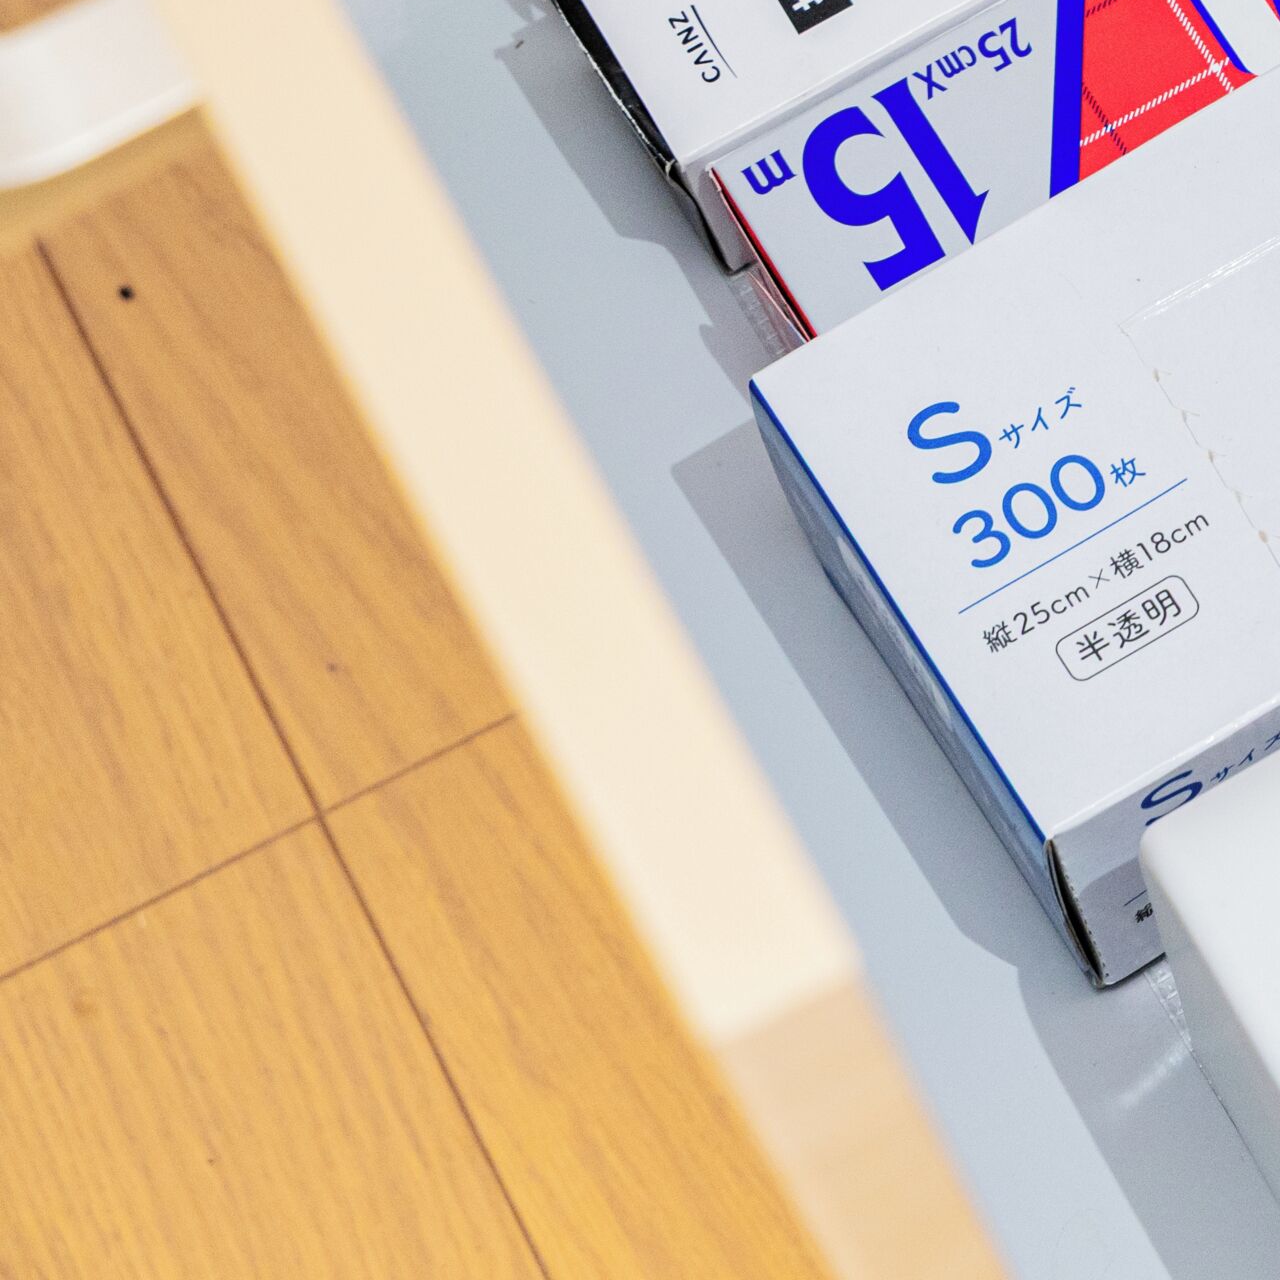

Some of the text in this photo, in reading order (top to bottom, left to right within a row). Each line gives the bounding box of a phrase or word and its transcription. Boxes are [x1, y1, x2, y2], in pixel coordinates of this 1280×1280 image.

[668, 10, 721, 84] CAINZ
[952, 453, 1147, 569] 300枚
[1075, 588, 1183, 663] 半透明
